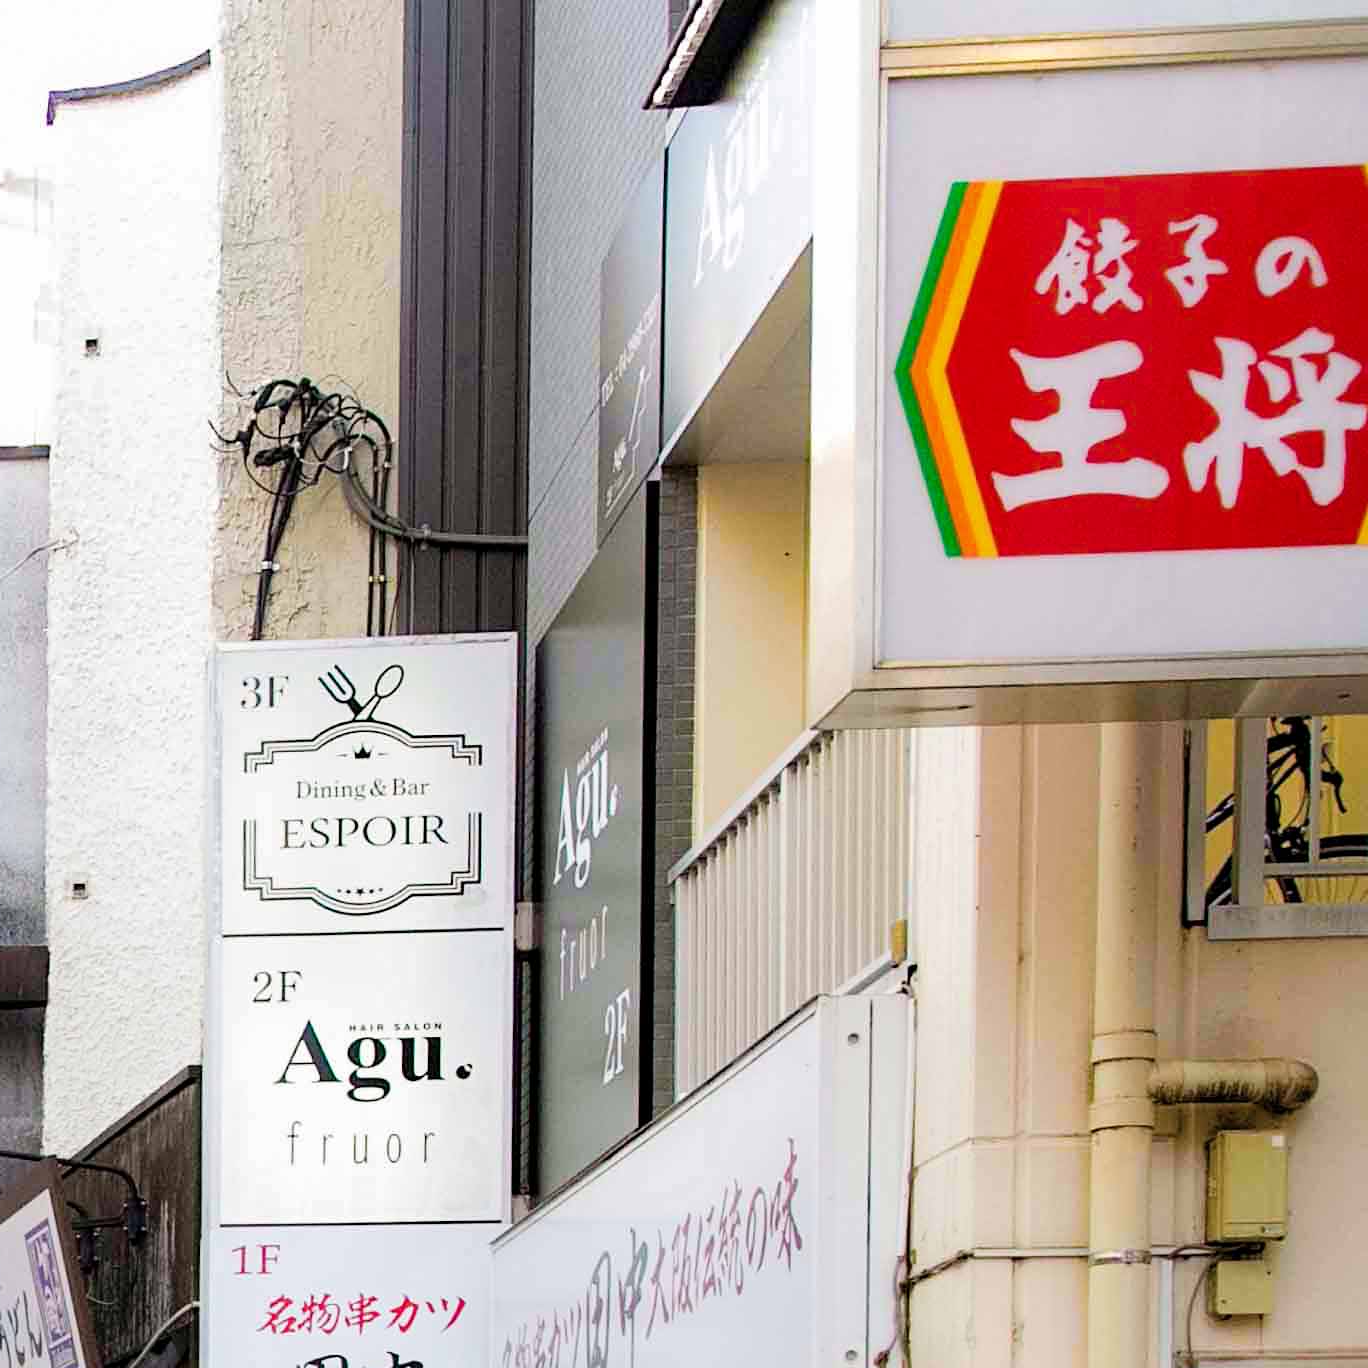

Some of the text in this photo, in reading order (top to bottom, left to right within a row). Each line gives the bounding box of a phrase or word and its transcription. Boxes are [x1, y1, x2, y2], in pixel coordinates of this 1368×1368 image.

[1035, 214, 1328, 314] 餃子の
[992, 327, 1368, 512] 王将
[240, 674, 289, 709] 3F
[296, 780, 366, 801] Dining
[392, 778, 430, 797] Bar
[280, 814, 448, 849] ESPOIR
[553, 750, 618, 888] Agu.
[559, 904, 609, 1000] fruor
[252, 970, 303, 1002] 2F
[349, 1022, 443, 1031] HAIR SALON
[603, 988, 630, 1085] 2F
[274, 1019, 473, 1102] Agu.
[288, 1120, 436, 1166] fruor
[232, 1244, 280, 1275] 1F
[255, 1293, 467, 1336] 名物串カツ
